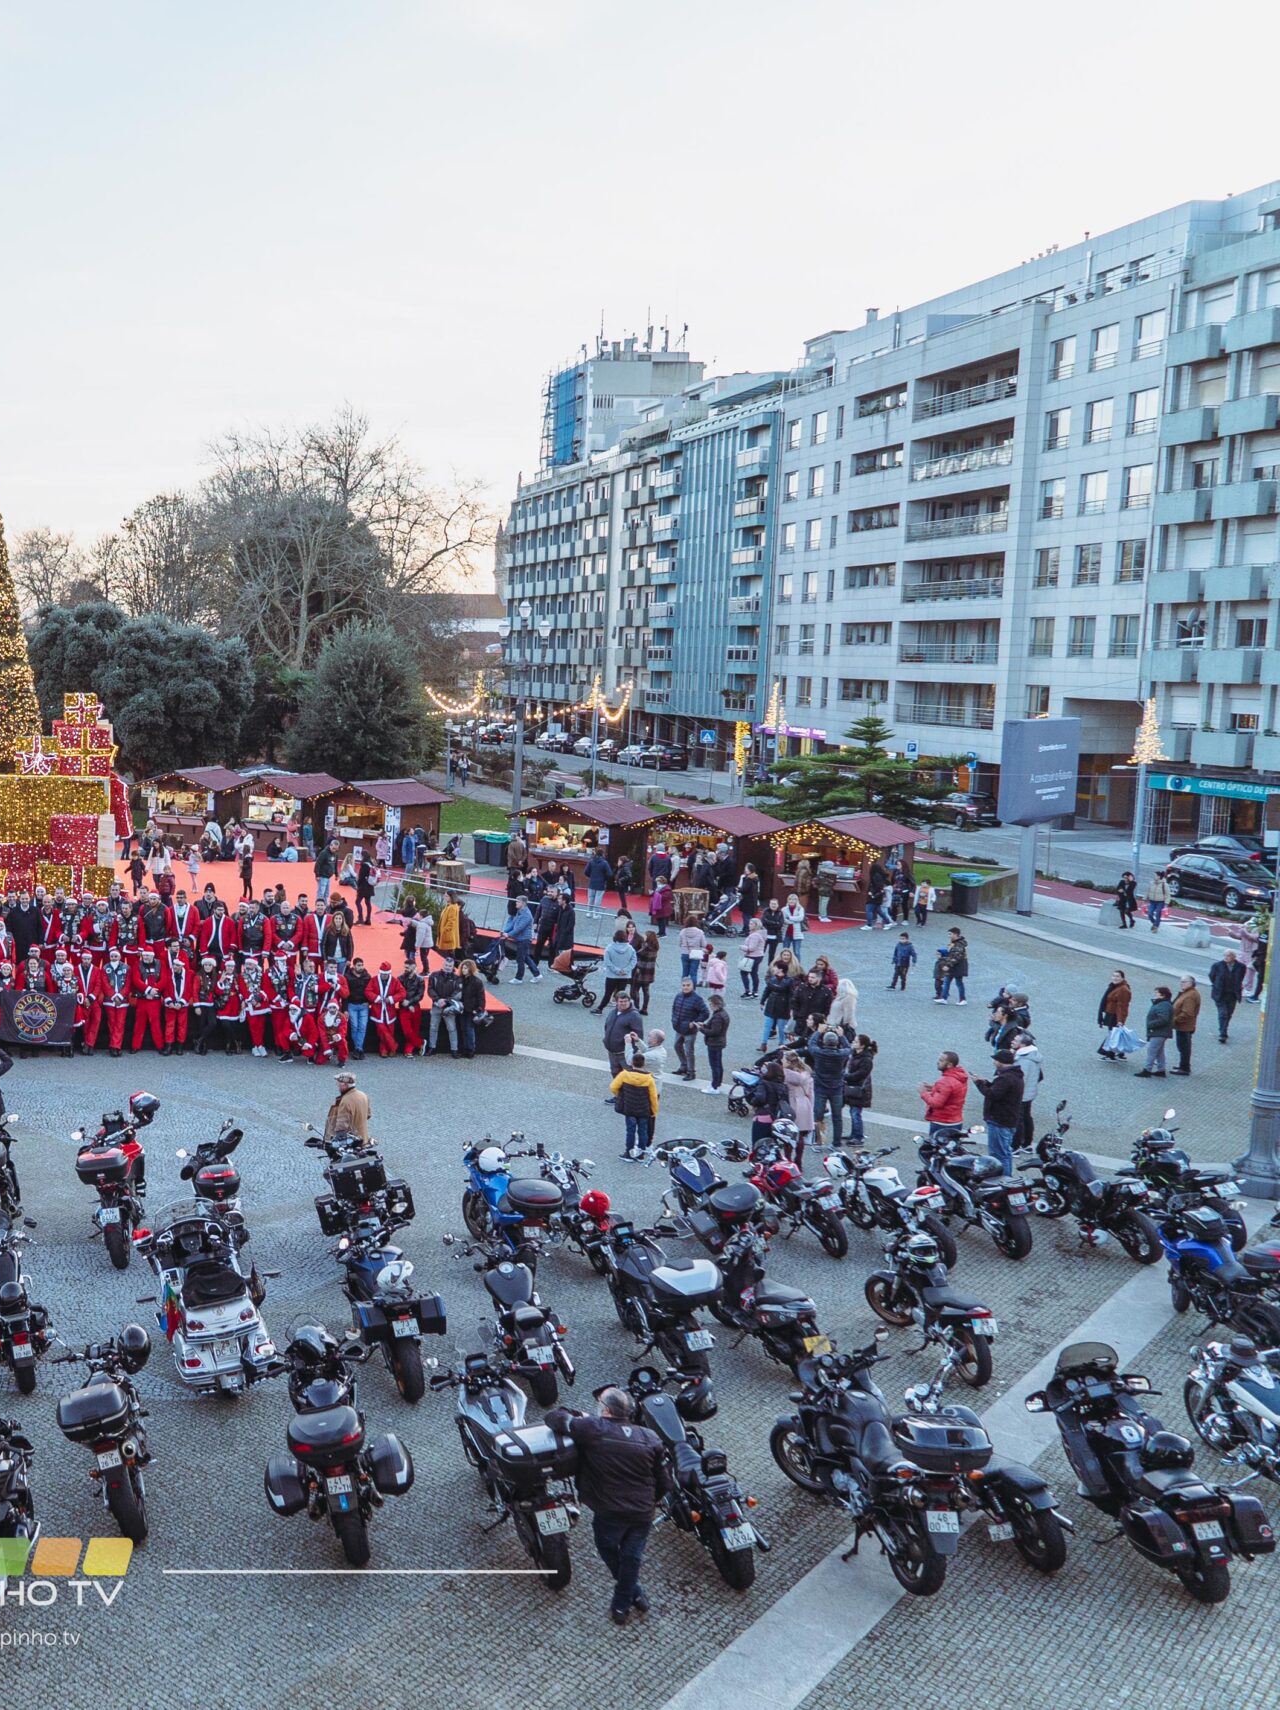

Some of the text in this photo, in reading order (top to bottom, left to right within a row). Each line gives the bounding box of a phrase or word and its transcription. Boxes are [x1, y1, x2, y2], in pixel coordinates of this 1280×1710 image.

[1199, 780, 1226, 790] CENTRO
[1227, 781, 1253, 793] ÓPTICO
[1253, 786, 1265, 794] DE
[678, 826, 713, 836] AREPAS
[35, 995, 54, 1017] CLUBE
[15, 1017, 54, 1035] ESPINHO
